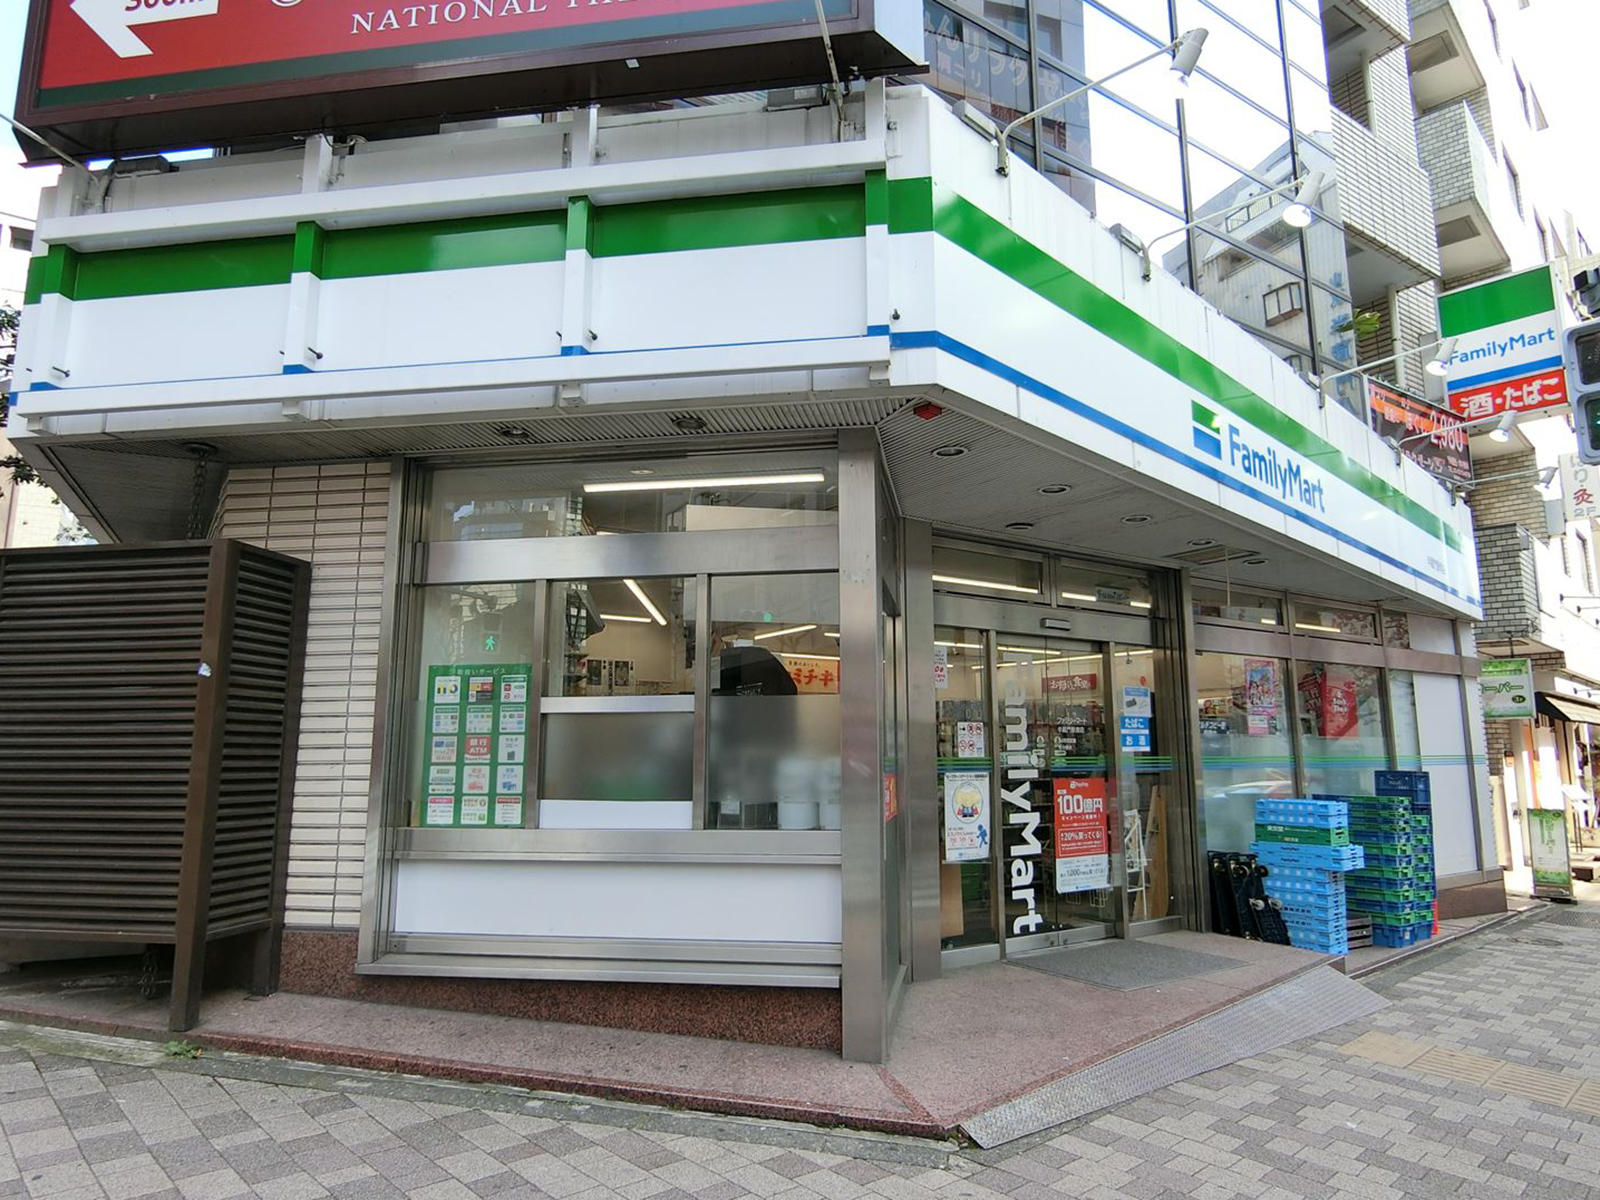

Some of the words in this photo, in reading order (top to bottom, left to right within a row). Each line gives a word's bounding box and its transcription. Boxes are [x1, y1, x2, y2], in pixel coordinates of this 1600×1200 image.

[350, 0, 548, 34] NATIONAL
[1449, 327, 1556, 366] FamilyMart
[1459, 376, 1563, 418] 酒・たばこ
[1228, 423, 1326, 514] FamilyMart
[1125, 718, 1145, 728] たばこ
